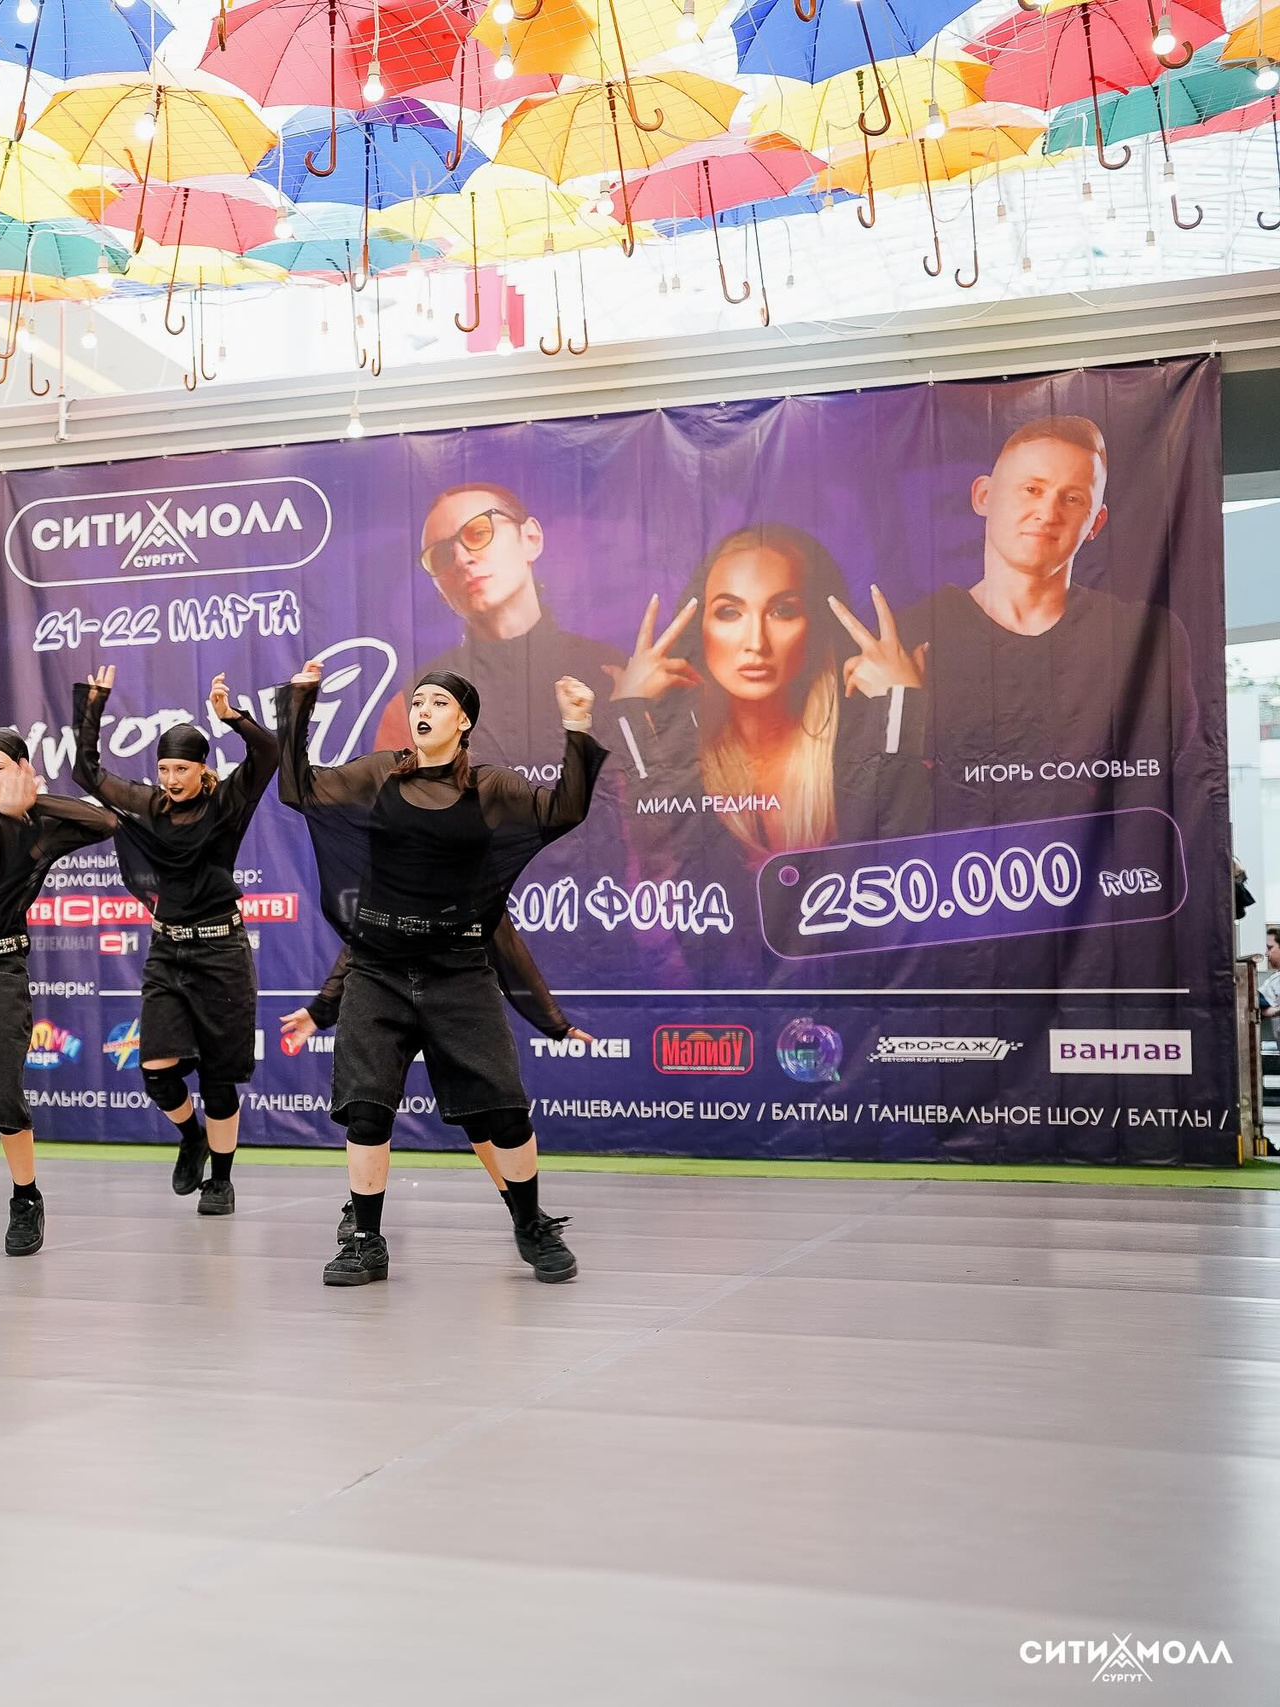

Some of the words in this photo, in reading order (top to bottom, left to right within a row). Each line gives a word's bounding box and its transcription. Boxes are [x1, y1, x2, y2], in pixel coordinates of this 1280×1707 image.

[133, 552, 187, 568] СУРГУТ
[33, 605, 162, 651] 21-22
[169, 589, 302, 643] МАРТА
[964, 764, 1033, 782] ИГОРЬ
[1040, 759, 1160, 781] СОЛОВЬЕВ
[637, 797, 696, 814] МИЛА
[702, 794, 781, 813] РЕДИНА
[798, 841, 1081, 936] 250.000
[1098, 868, 1162, 897] RUB
[585, 876, 734, 934] ФОНД
[530, 1038, 586, 1058] TWO
[591, 1038, 630, 1058] KEI
[898, 1041, 991, 1052] ФОРСАЖ
[1060, 1043, 1182, 1060] ванлав
[24, 1090, 107, 1108] ЕВАЛЬНОЕ
[110, 1091, 151, 1109] ШОУ
[540, 1098, 694, 1120] ТАНЦЕВАЛЬНОЕ
[700, 1101, 751, 1121] ШОУ
[771, 1103, 848, 1121] БАТТЛЫ
[868, 1104, 1041, 1125] ТАНЦЕВАЛЬНОЕ
[1047, 1106, 1104, 1126] ШОУ
[1128, 1107, 1213, 1128] БАТТЛЫ
